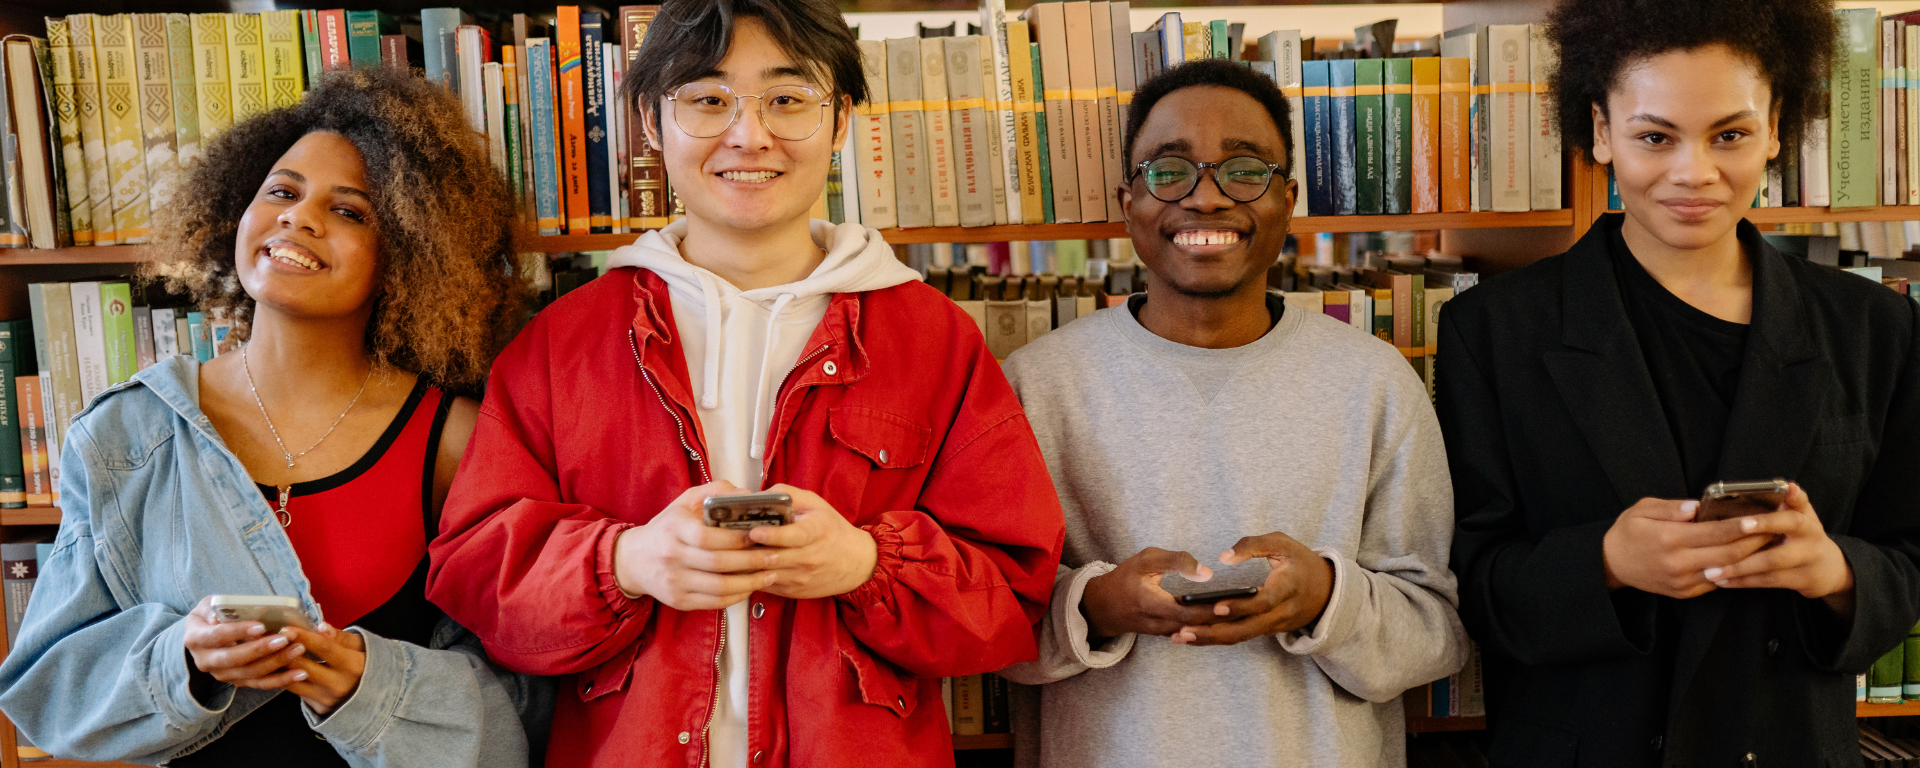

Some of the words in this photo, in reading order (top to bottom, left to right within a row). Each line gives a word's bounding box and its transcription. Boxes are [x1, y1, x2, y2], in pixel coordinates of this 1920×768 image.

[63, 102, 71, 113] 3
[85, 102, 92, 112] 5
[116, 103, 123, 112] 6
[155, 103, 160, 112] 7
[1860, 68, 1872, 142] издания
[933, 110, 943, 132] ПЕС
[870, 102, 883, 162] БАЛАД
